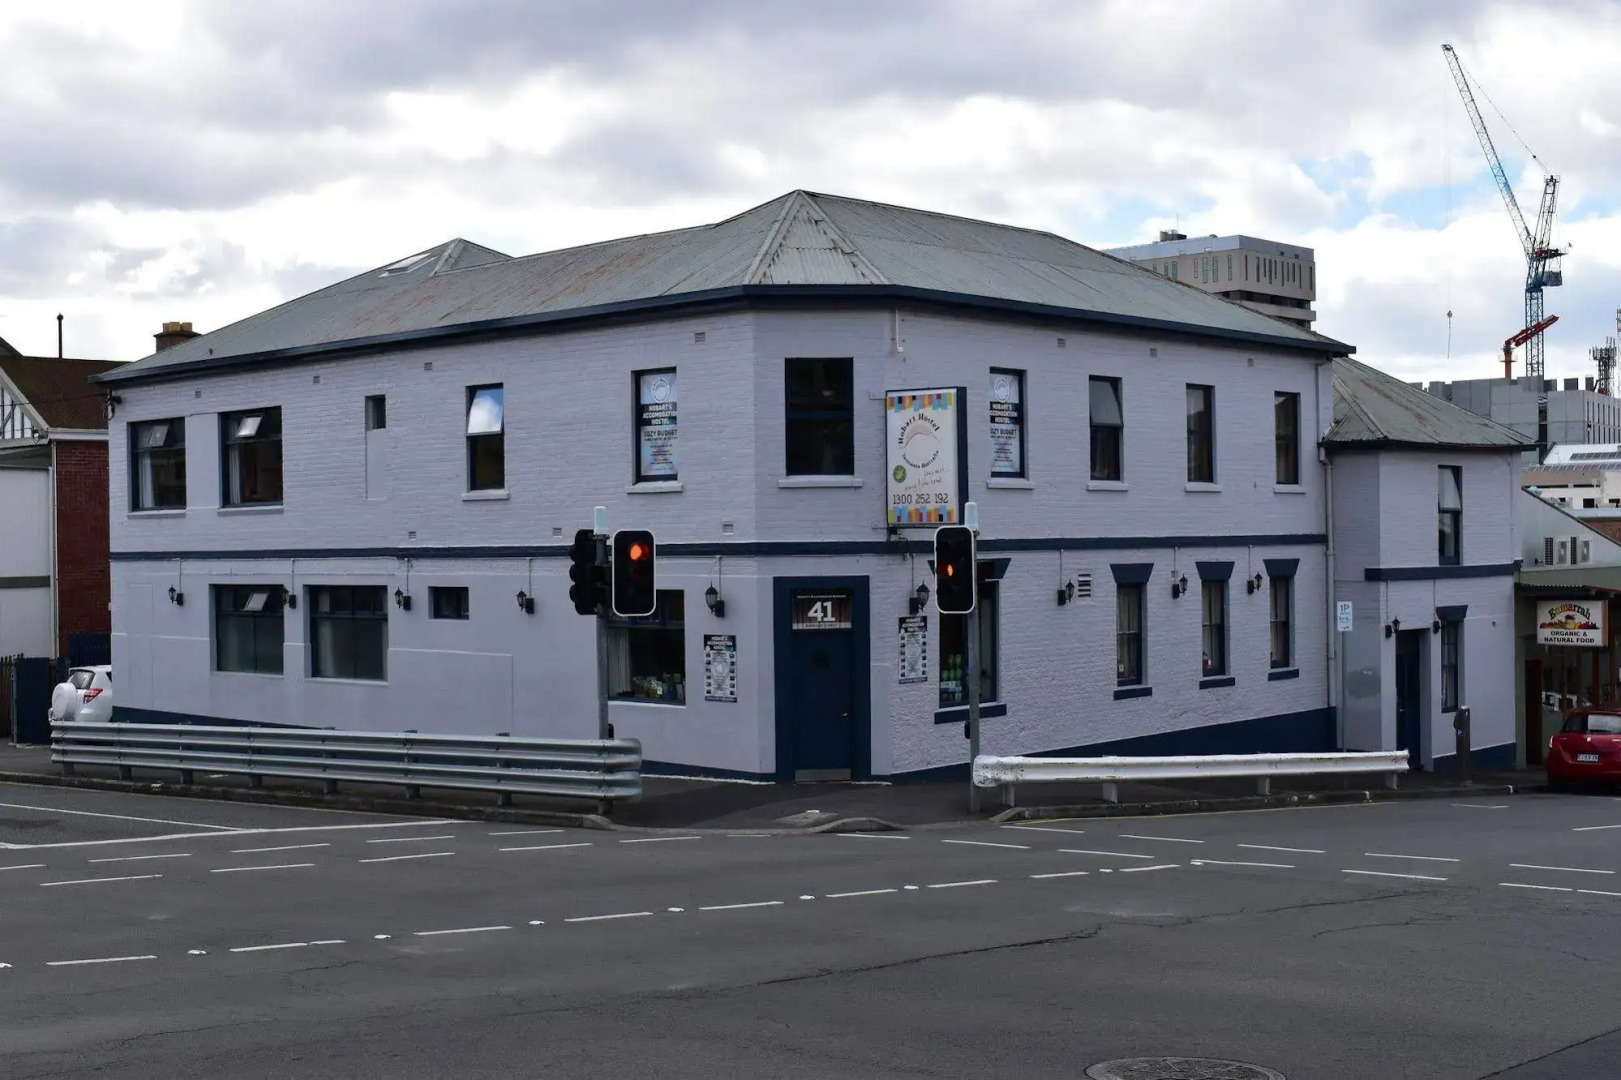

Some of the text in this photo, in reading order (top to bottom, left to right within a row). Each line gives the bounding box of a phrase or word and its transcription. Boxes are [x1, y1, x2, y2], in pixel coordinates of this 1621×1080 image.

[898, 413, 940, 444] Hobart Hostel
[893, 492, 949, 505] 1300 252 192
[807, 600, 836, 622] 41
